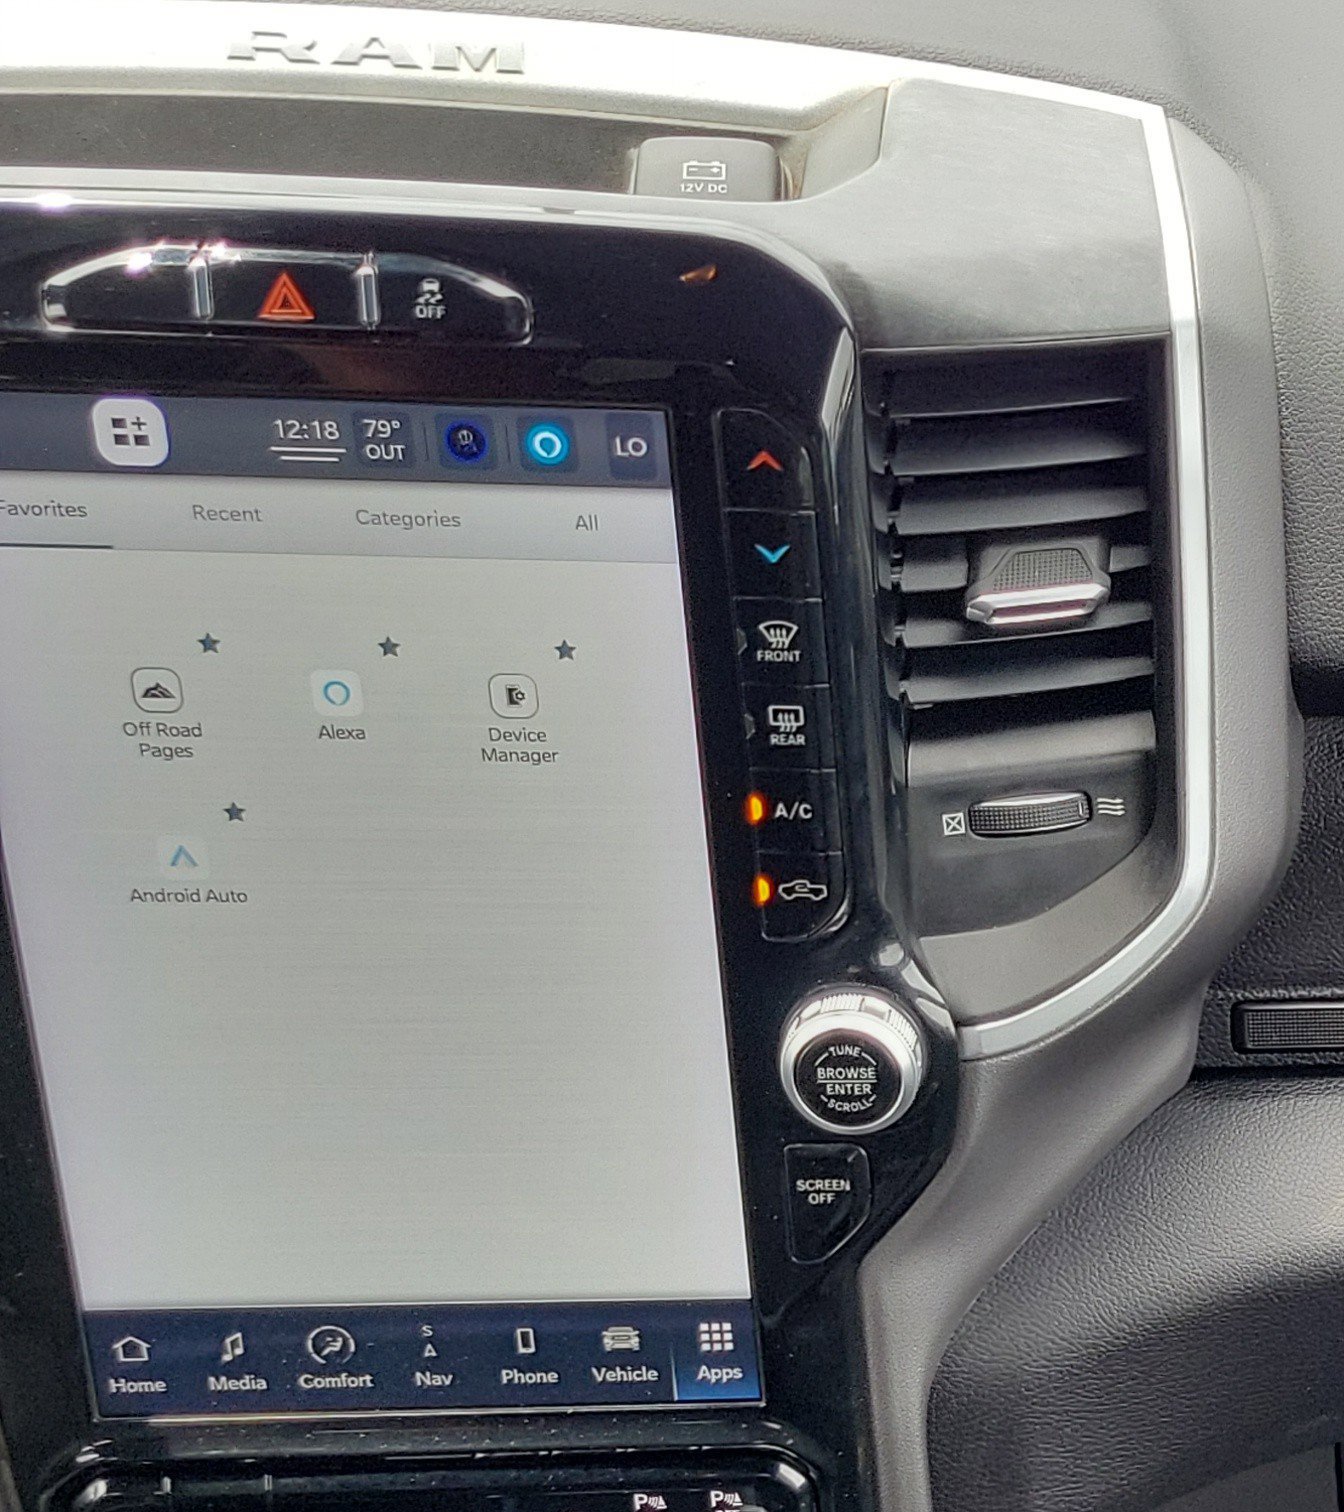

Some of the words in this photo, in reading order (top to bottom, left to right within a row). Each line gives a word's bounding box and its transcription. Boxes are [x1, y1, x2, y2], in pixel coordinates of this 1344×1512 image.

[227, 30, 525, 75] RAM
[680, 183, 704, 193] 12V
[706, 183, 728, 194] DC
[415, 304, 447, 320] OFF
[273, 419, 341, 440] 12:18
[365, 444, 406, 461] OUT
[615, 436, 648, 458] LO
[192, 504, 262, 523] Recent
[355, 509, 462, 531] Categories
[575, 513, 600, 531] All
[757, 650, 801, 662] FRONT
[123, 722, 152, 739] Off
[156, 722, 203, 739] Road
[318, 724, 366, 741] Alexa
[488, 727, 547, 744] Device
[770, 733, 806, 746] REAR
[139, 742, 194, 761] Pages
[481, 748, 559, 767] Manager
[774, 802, 813, 820] A/C
[130, 888, 201, 904] Android
[205, 889, 249, 904] Auto
[828, 1045, 862, 1058] TUNE
[817, 1067, 877, 1080] BROWSE
[826, 1083, 873, 1095] ENTER
[827, 1098, 873, 1112] SCROLL
[796, 1179, 851, 1192] SCREEN
[807, 1192, 836, 1205] OFF
[298, 1373, 375, 1390] Comfort
[414, 1371, 454, 1387] Nav
[501, 1368, 560, 1385] Phone
[591, 1366, 660, 1383] Vehicle
[697, 1365, 744, 1386] Apps
[108, 1378, 168, 1394] Home
[207, 1375, 268, 1392] Media
